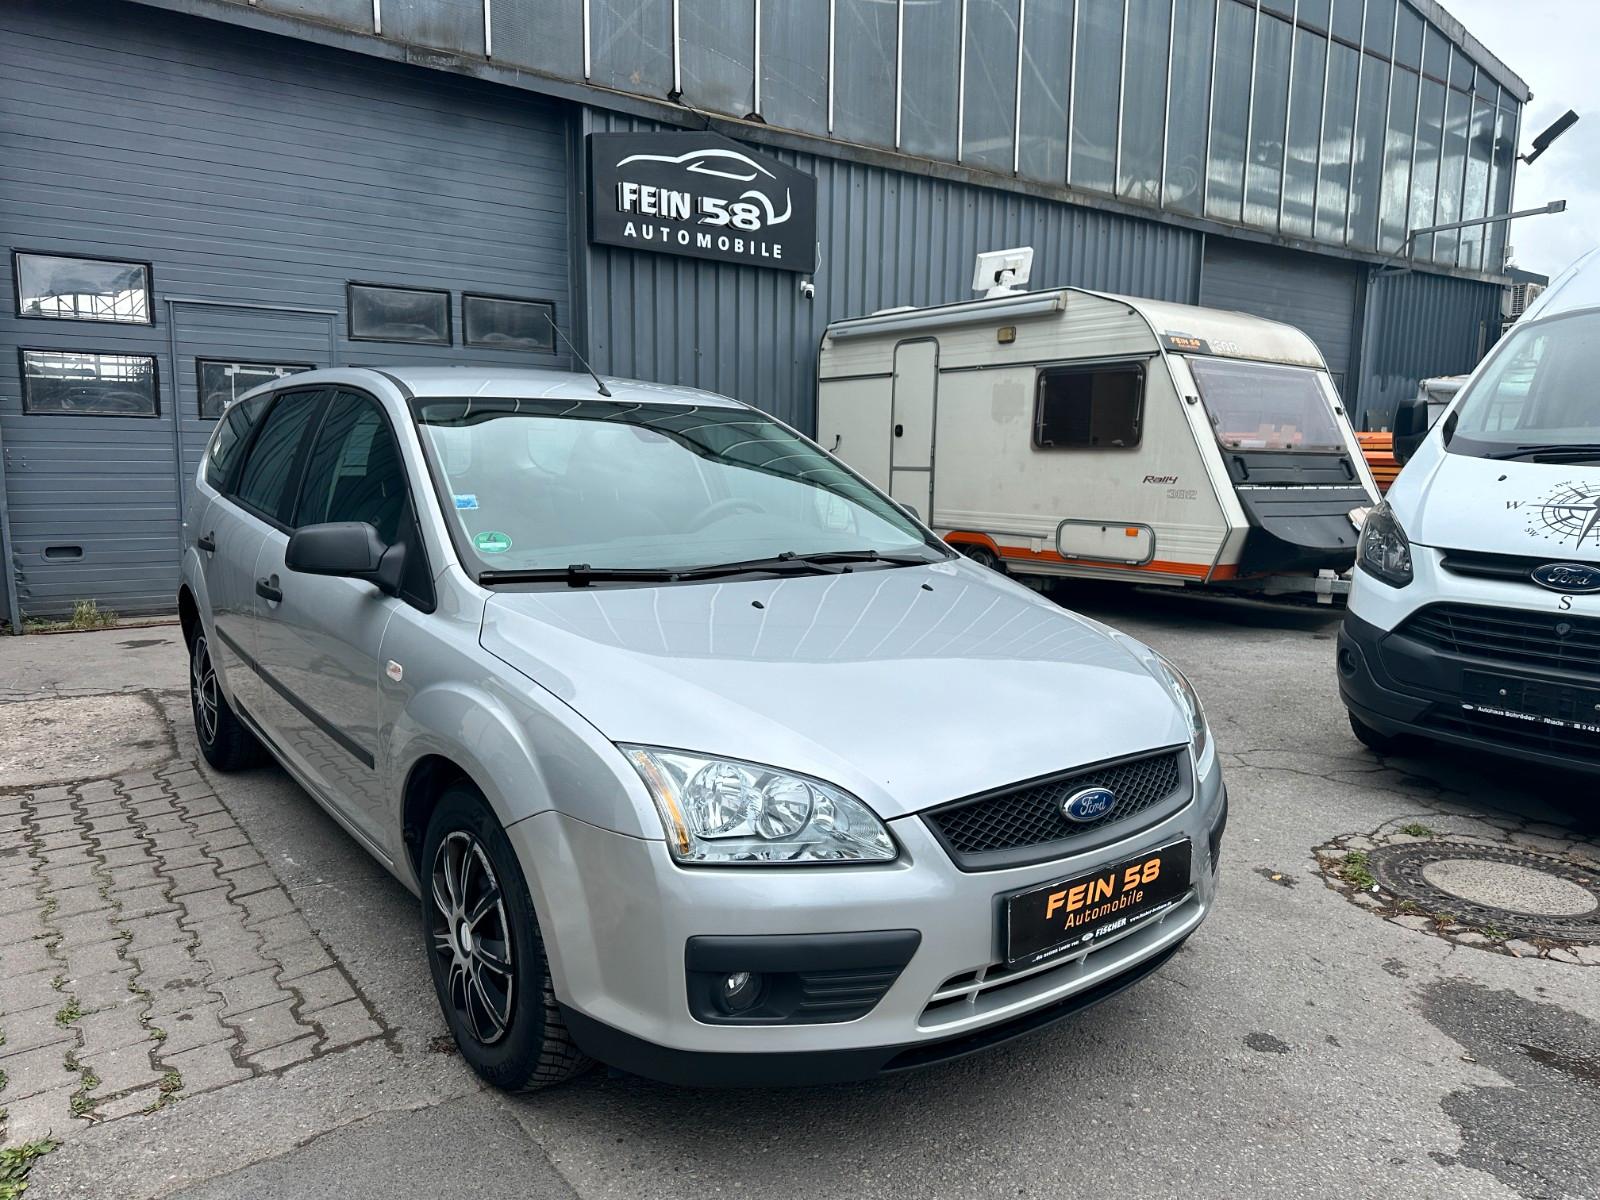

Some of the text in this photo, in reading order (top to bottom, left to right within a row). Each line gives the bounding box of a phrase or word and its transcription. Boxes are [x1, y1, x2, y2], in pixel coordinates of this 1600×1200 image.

[617, 182, 761, 232] FEIN 58
[624, 222, 782, 259] AUTOMOBILE
[1143, 475, 1179, 485] Rally
[1506, 500, 1526, 510] W
[1547, 566, 1593, 586] Ford
[1558, 595, 1573, 610] S
[1080, 795, 1106, 816] Ford
[1046, 874, 1116, 919] FEIN
[1122, 858, 1161, 892] 58
[1064, 889, 1144, 930] Automobile
[1095, 917, 1127, 938] FISCHER
